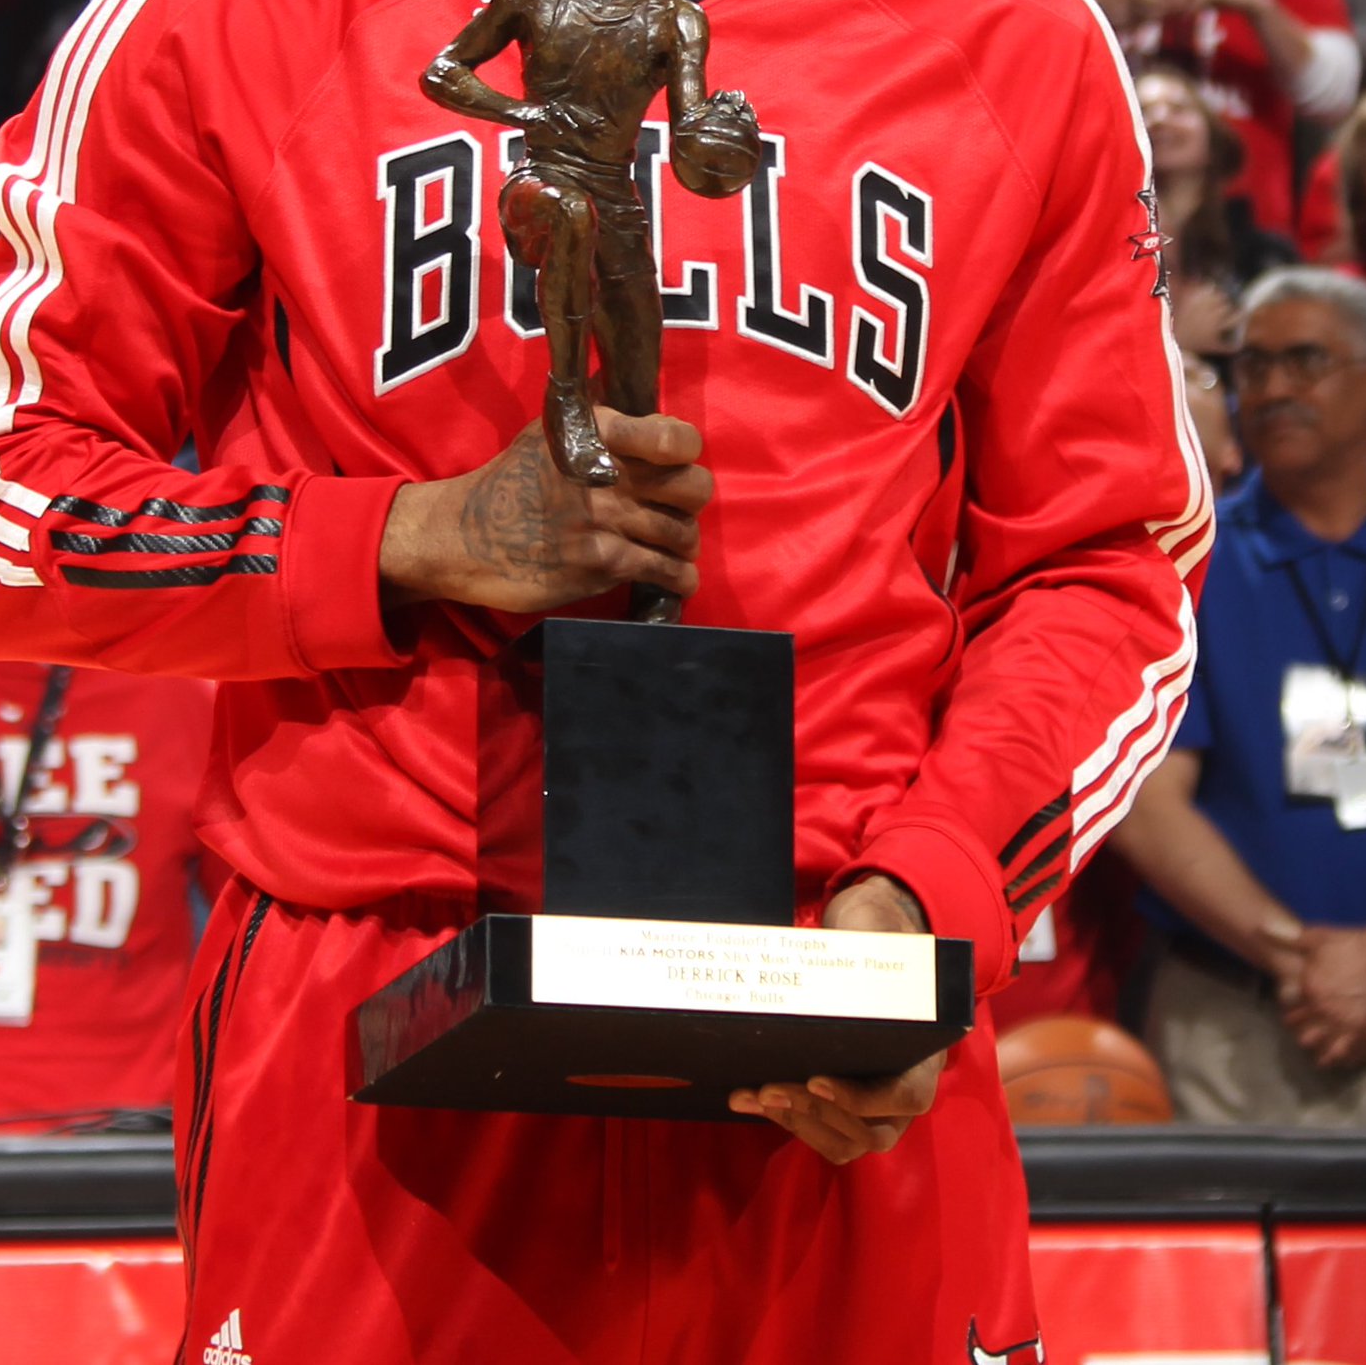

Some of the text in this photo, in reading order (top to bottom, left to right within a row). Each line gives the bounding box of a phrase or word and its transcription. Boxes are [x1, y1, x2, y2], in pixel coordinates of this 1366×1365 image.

[619, 946, 646, 957] KIA
[652, 947, 716, 961] MOTORS
[667, 965, 804, 987] DERRICK ROSE
[750, 990, 785, 1004] Bulls
[203, 1346, 252, 1365] adidas
